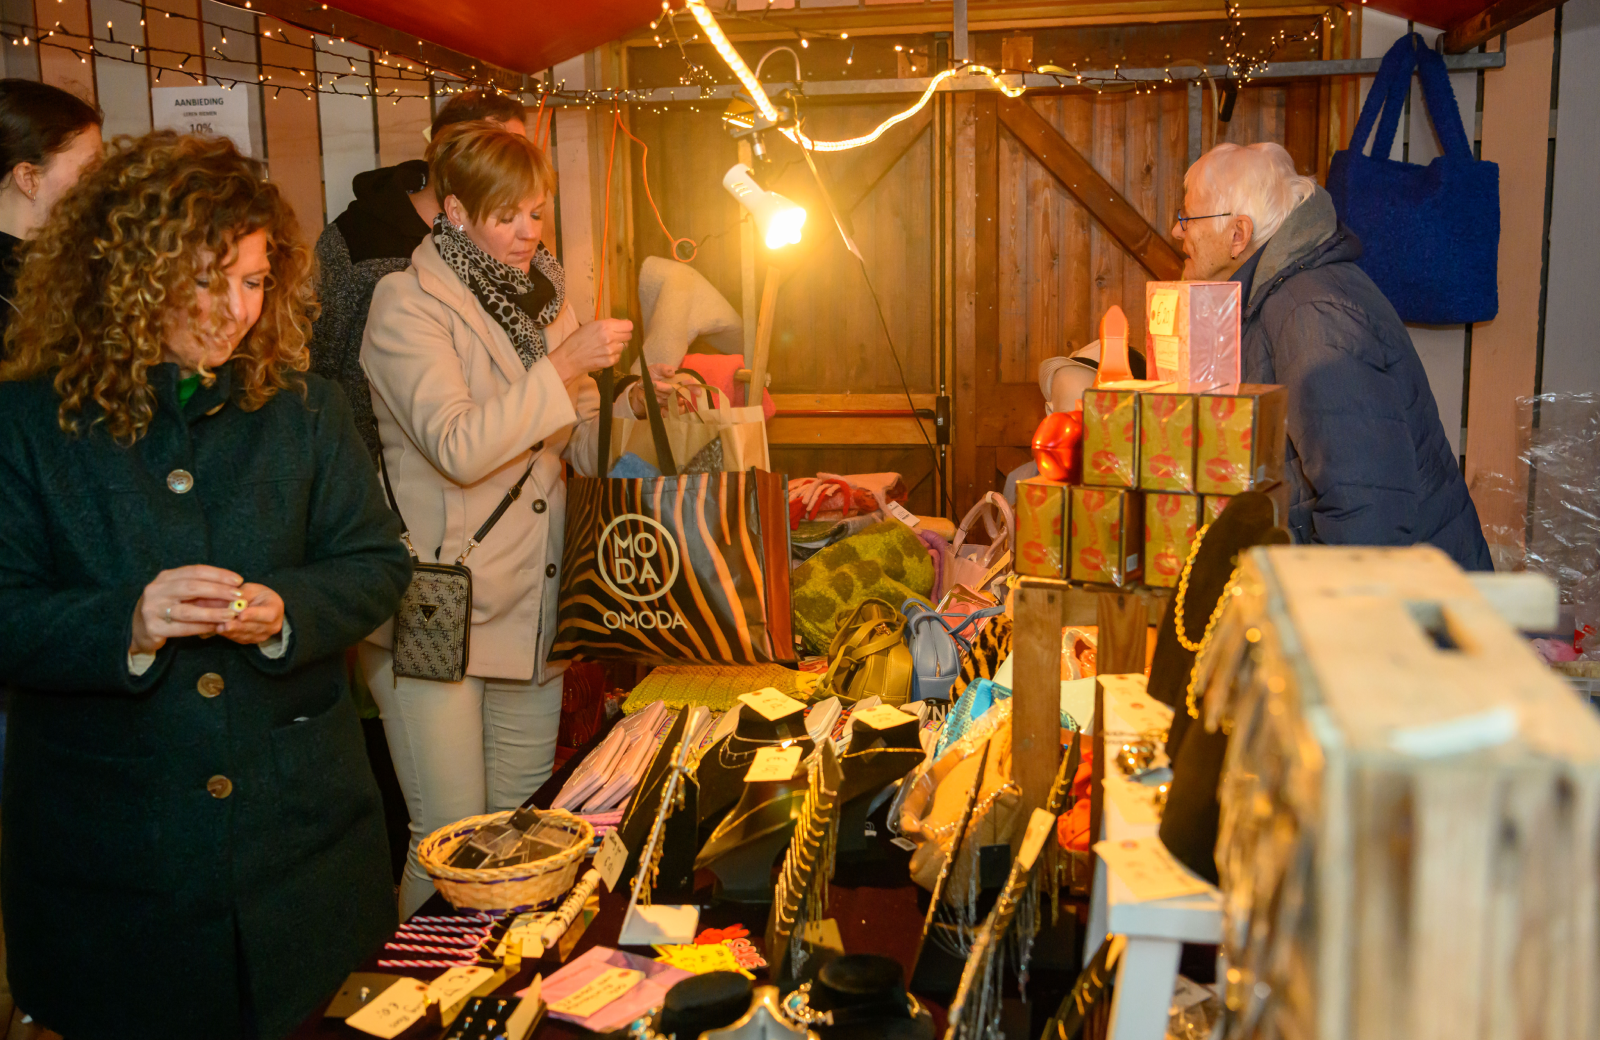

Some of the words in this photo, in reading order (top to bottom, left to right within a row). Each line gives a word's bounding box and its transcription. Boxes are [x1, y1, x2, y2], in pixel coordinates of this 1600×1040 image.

[174, 97, 224, 106] AANBIEDING
[190, 122, 213, 134] 10%
[613, 532, 658, 558] MO
[614, 558, 661, 584] DA
[603, 610, 688, 629] OMODA
